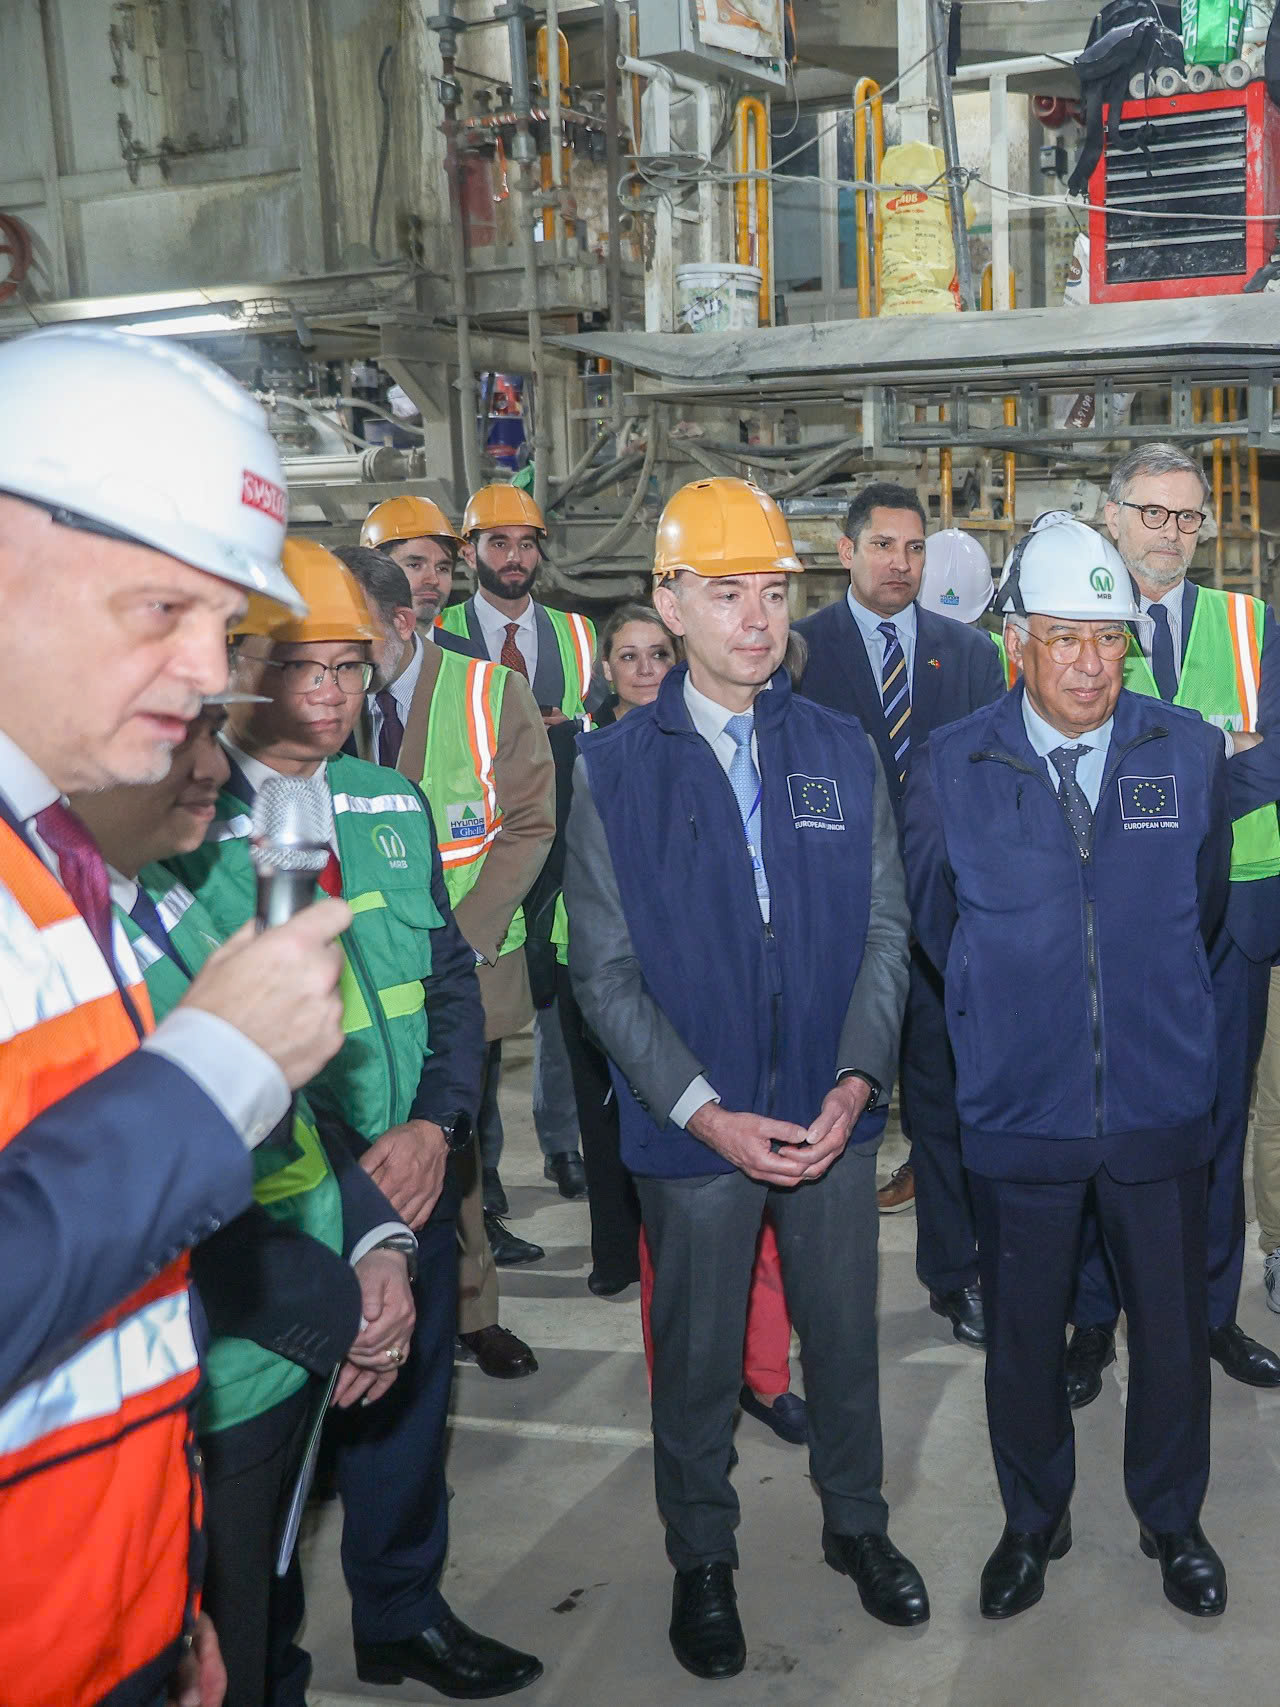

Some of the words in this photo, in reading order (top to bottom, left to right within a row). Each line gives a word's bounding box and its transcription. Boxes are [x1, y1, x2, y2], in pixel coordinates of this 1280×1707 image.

[450, 817, 485, 828] HYUNDA
[795, 820, 826, 829] EUROPEAN
[1123, 822, 1159, 830] EUROPEAN
[1160, 821, 1179, 829] UNION
[388, 860, 408, 868] MRB
